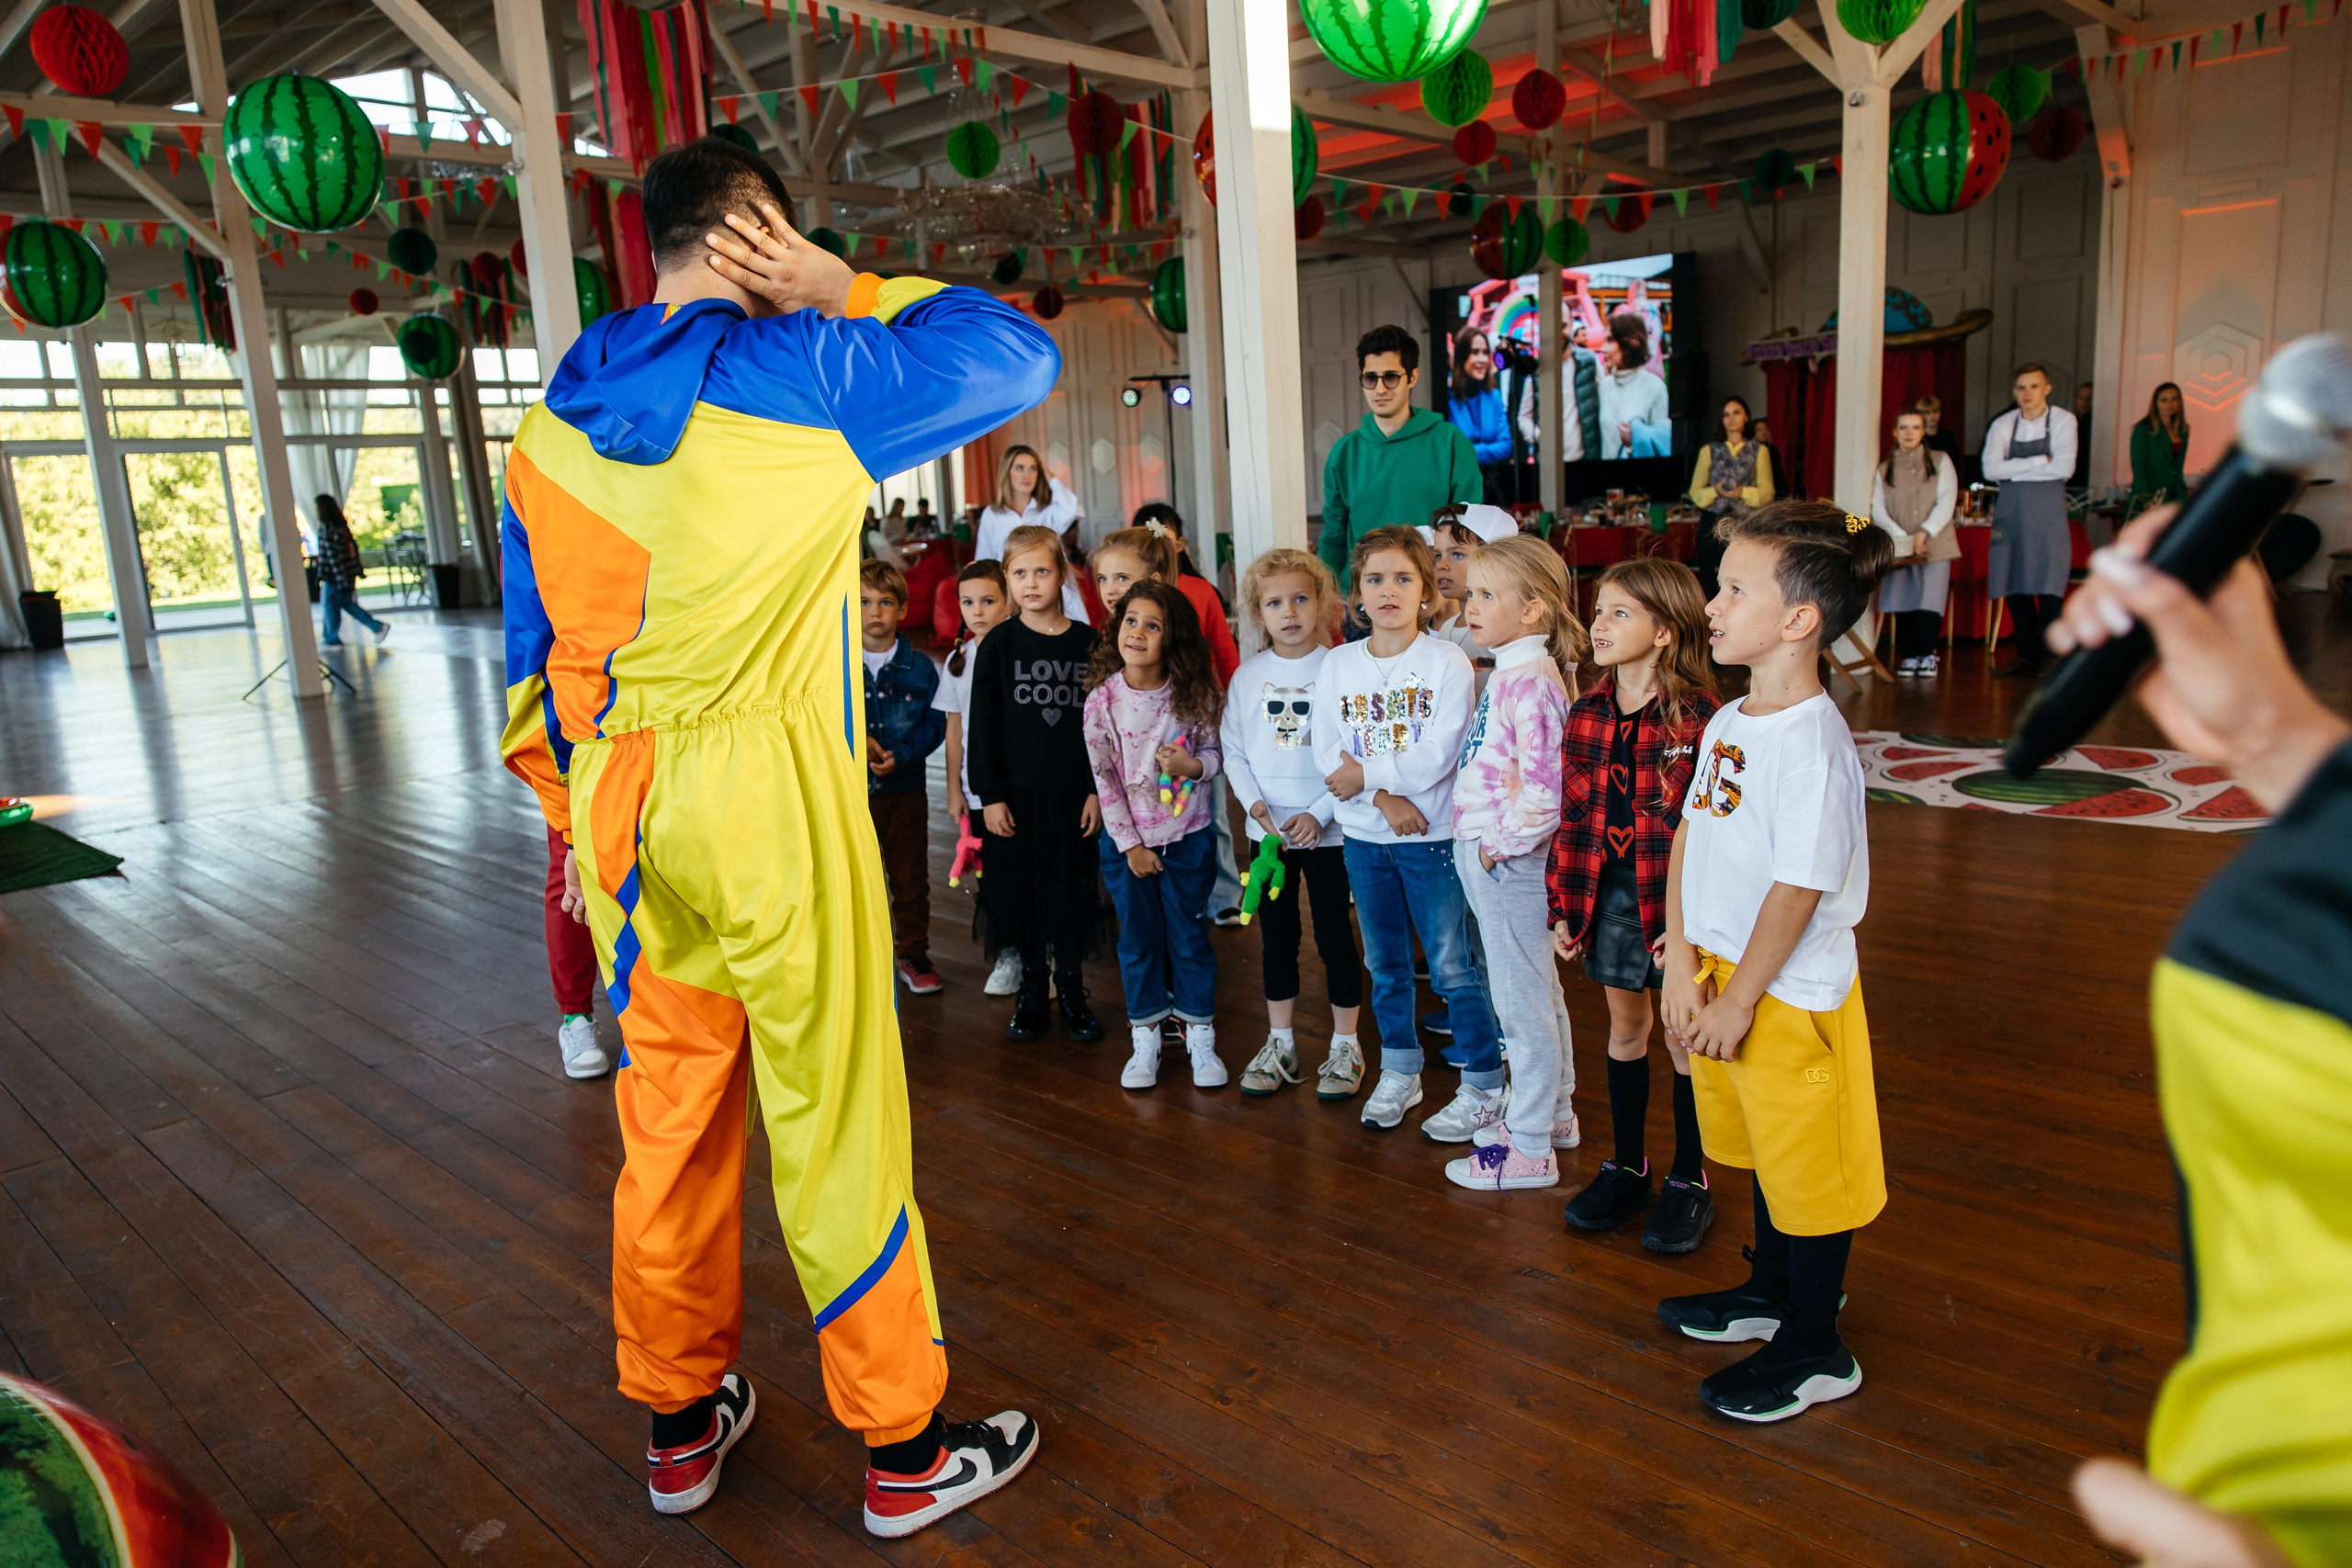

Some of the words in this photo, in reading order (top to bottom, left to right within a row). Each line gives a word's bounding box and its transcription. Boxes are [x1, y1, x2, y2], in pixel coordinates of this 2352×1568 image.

[1013, 659, 1089, 683] LOVE
[1013, 682, 1085, 708] COOL
[1804, 1067, 1830, 1084] DG
